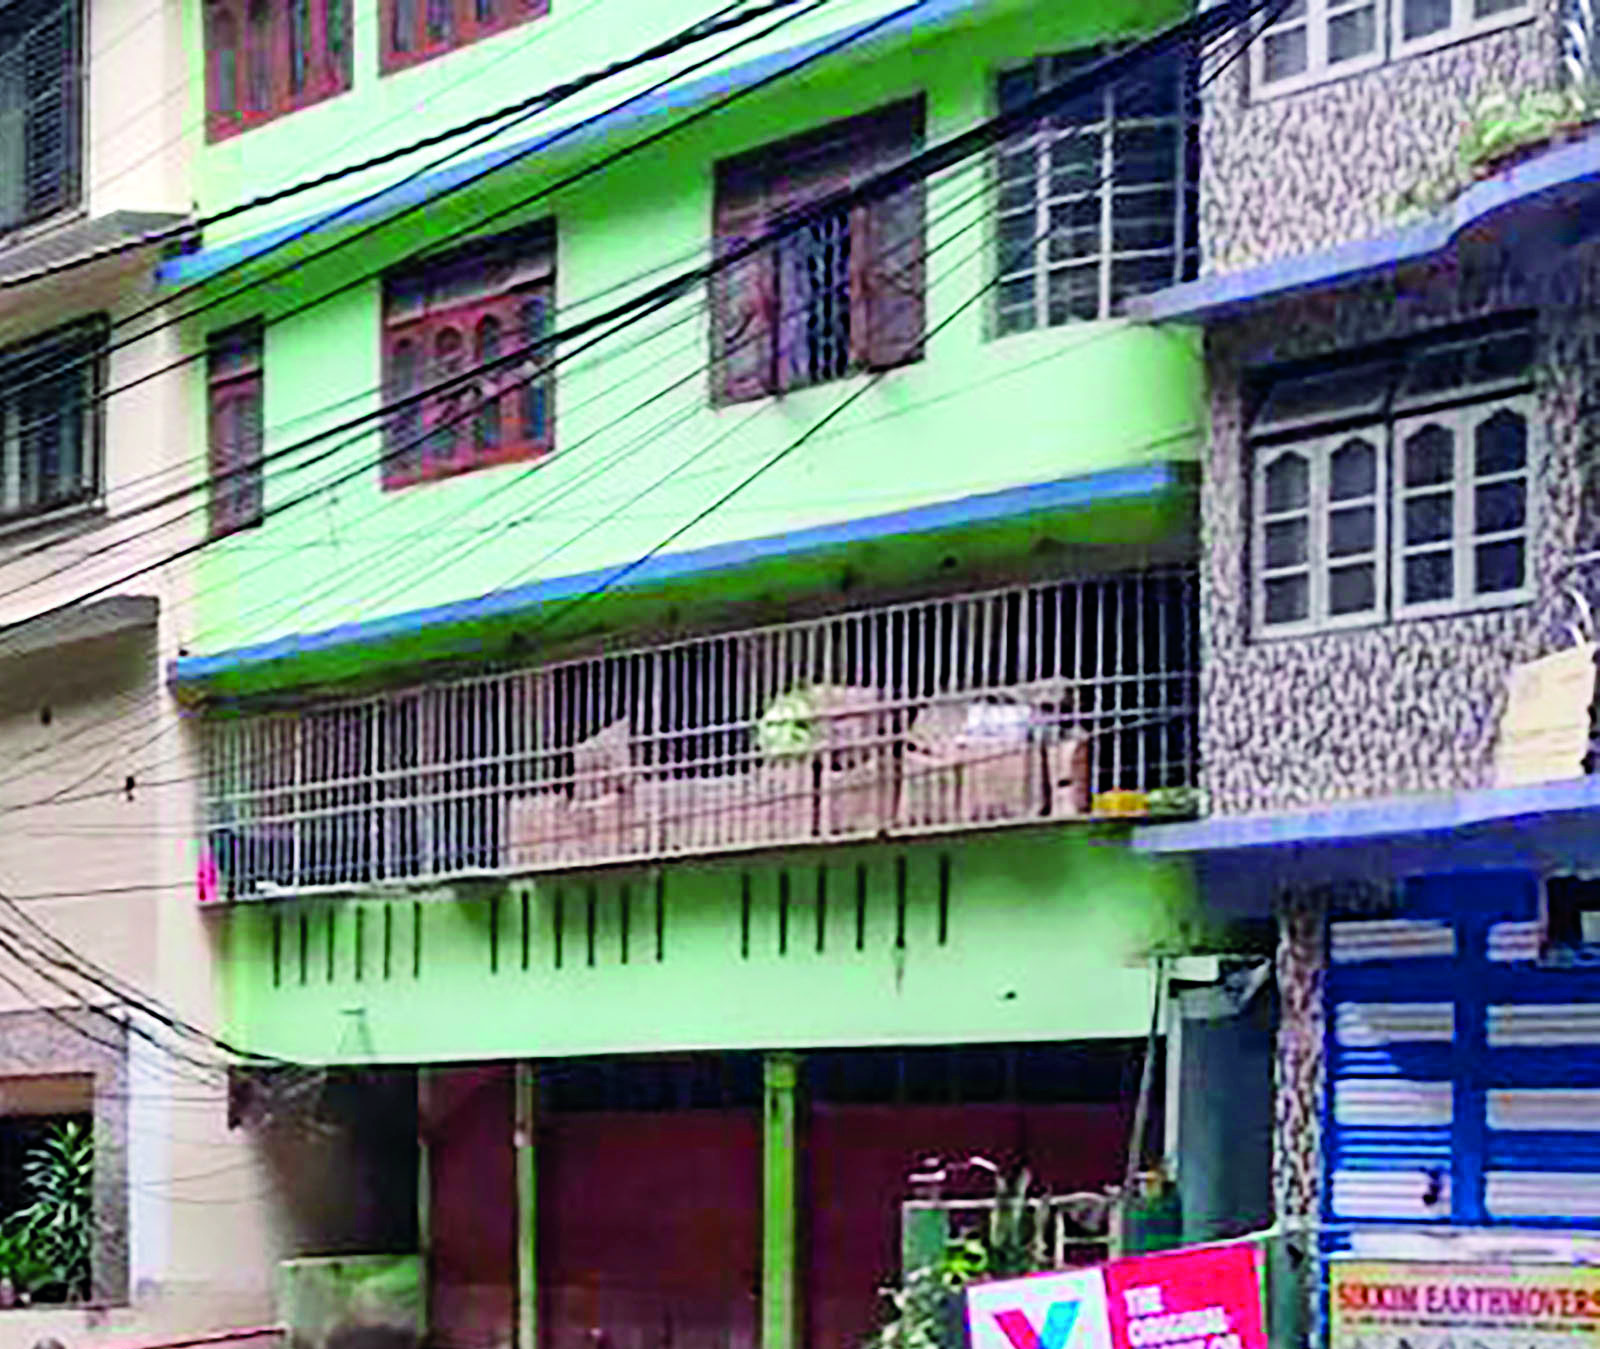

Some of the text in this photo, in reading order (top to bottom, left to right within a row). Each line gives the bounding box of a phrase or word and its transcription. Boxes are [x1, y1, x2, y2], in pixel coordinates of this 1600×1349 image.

[1123, 1285, 1165, 1316] THE
[1338, 1283, 1600, 1318] SIKKIM EARTHMOVERS
[1128, 1306, 1230, 1347] ORIGINAL
